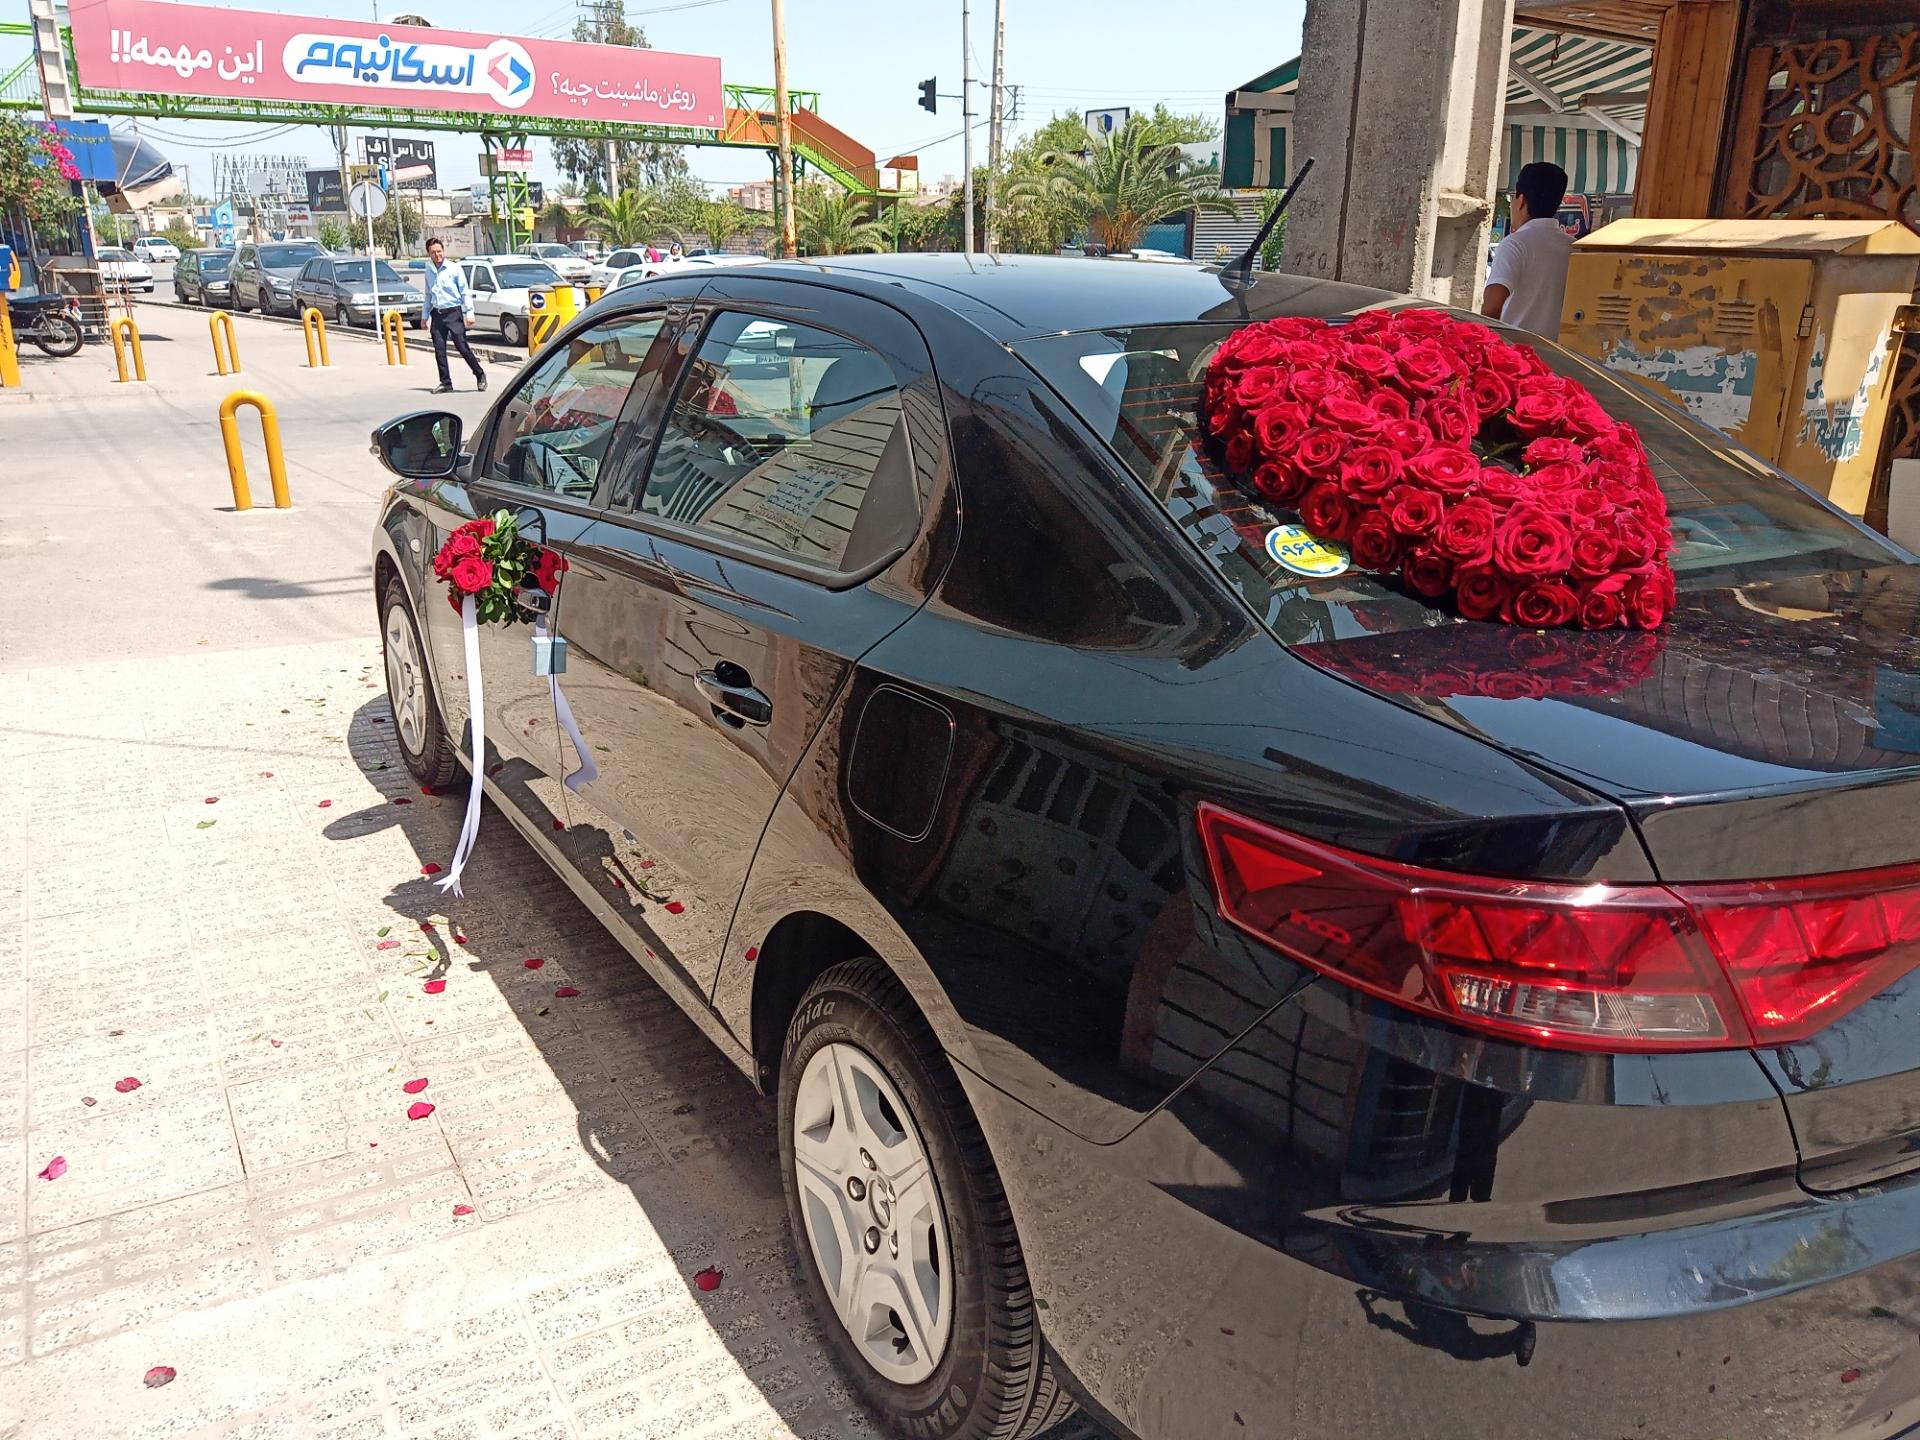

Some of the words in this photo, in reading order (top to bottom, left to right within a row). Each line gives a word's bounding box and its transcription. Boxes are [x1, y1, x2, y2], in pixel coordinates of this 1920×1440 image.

[110, 29, 213, 78] مهمه!!
[216, 39, 264, 85] این
[296, 35, 476, 87] اسکانیوم
[550, 71, 593, 106] چیه؟
[594, 79, 659, 108] ماشینت
[658, 83, 697, 111] روغن
[786, 997, 836, 1061] Elpida
